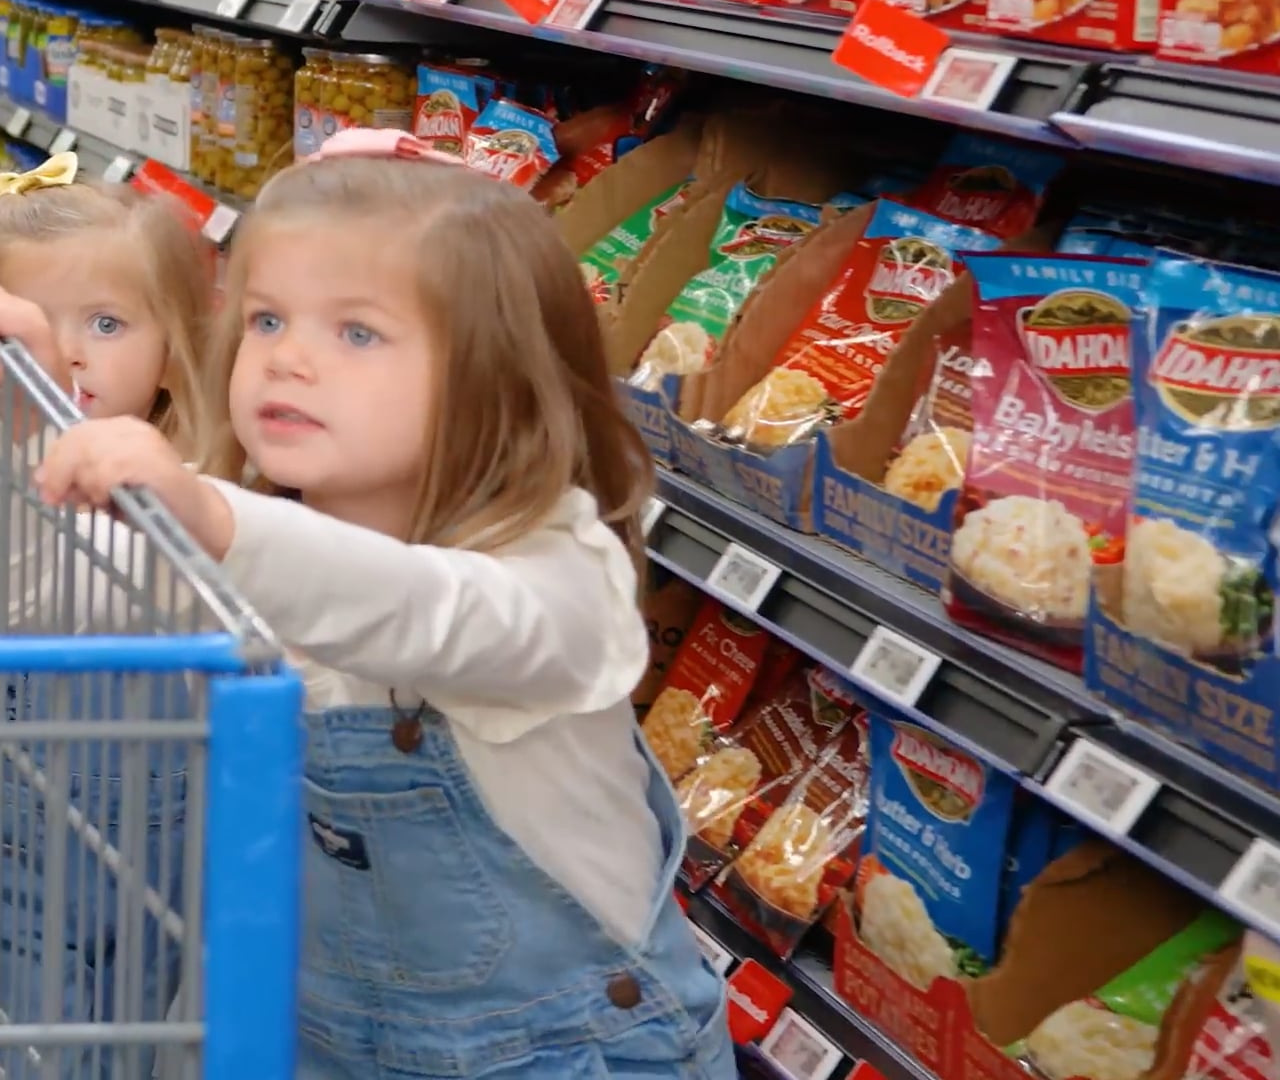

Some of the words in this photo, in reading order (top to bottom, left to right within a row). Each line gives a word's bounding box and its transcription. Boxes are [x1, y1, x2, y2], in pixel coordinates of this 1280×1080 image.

[851, 22, 928, 76] Rollback
[994, 395, 1078, 452] Baby
[822, 474, 898, 536] FAMILY
[898, 518, 952, 560] SIZE
[1194, 678, 1273, 746] SIZE
